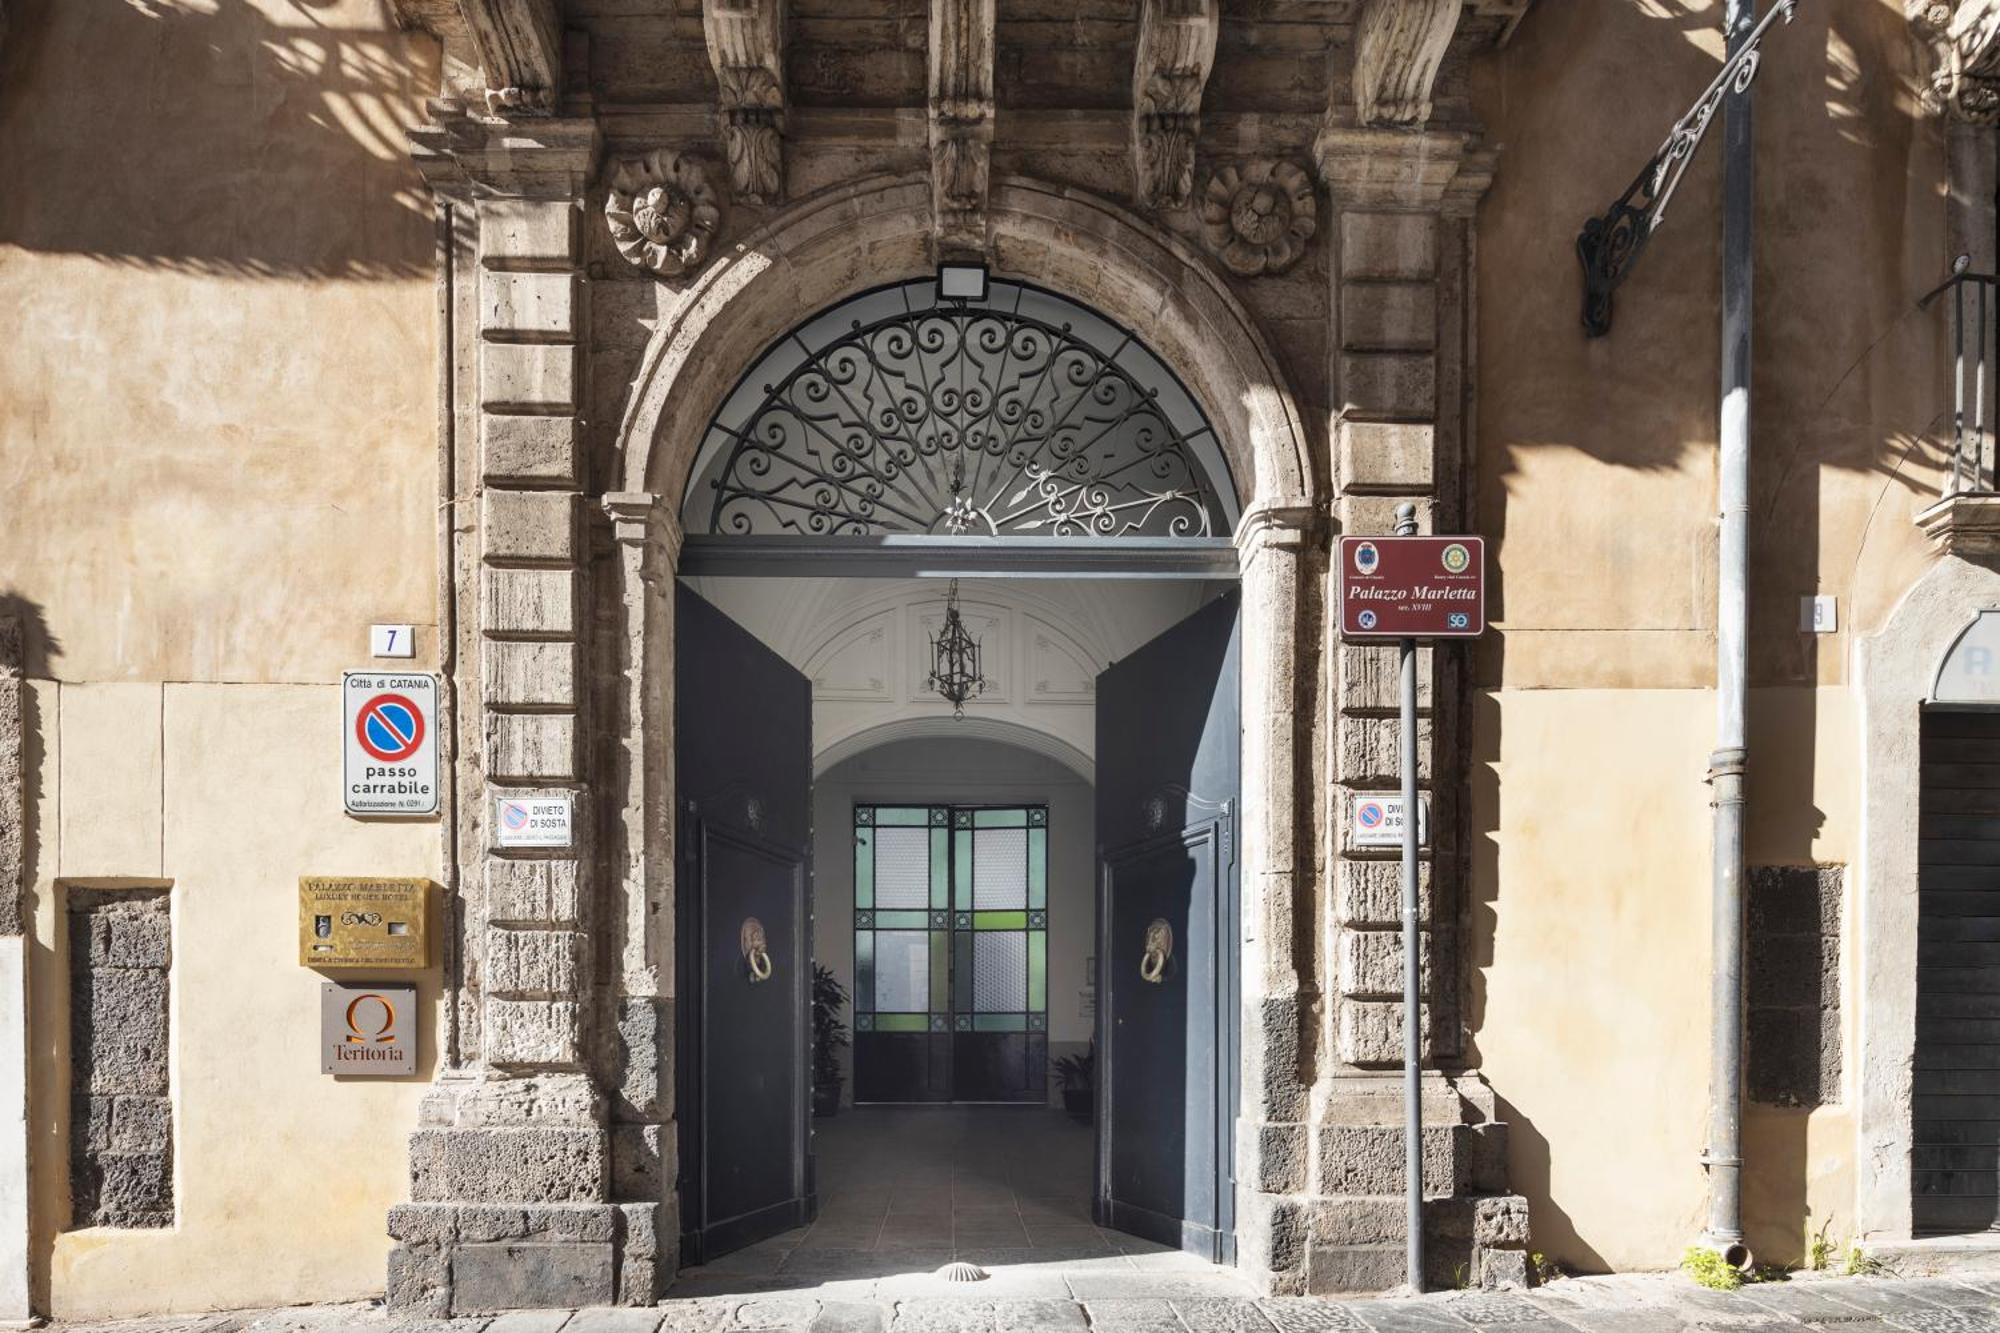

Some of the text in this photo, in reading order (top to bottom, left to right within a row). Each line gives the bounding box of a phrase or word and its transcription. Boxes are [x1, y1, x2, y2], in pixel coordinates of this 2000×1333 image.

[1349, 586, 1476, 601] Palazzo Marletta
[387, 630, 397, 652] 7
[350, 678, 429, 689] Città di CATANIA
[366, 767, 417, 780] passo
[352, 781, 430, 794] carrabile
[533, 805, 564, 815] DIVIETO
[530, 819, 567, 829] DI SOSTA
[1385, 817, 1394, 826] DI
[333, 1044, 403, 1061] Teritoria
